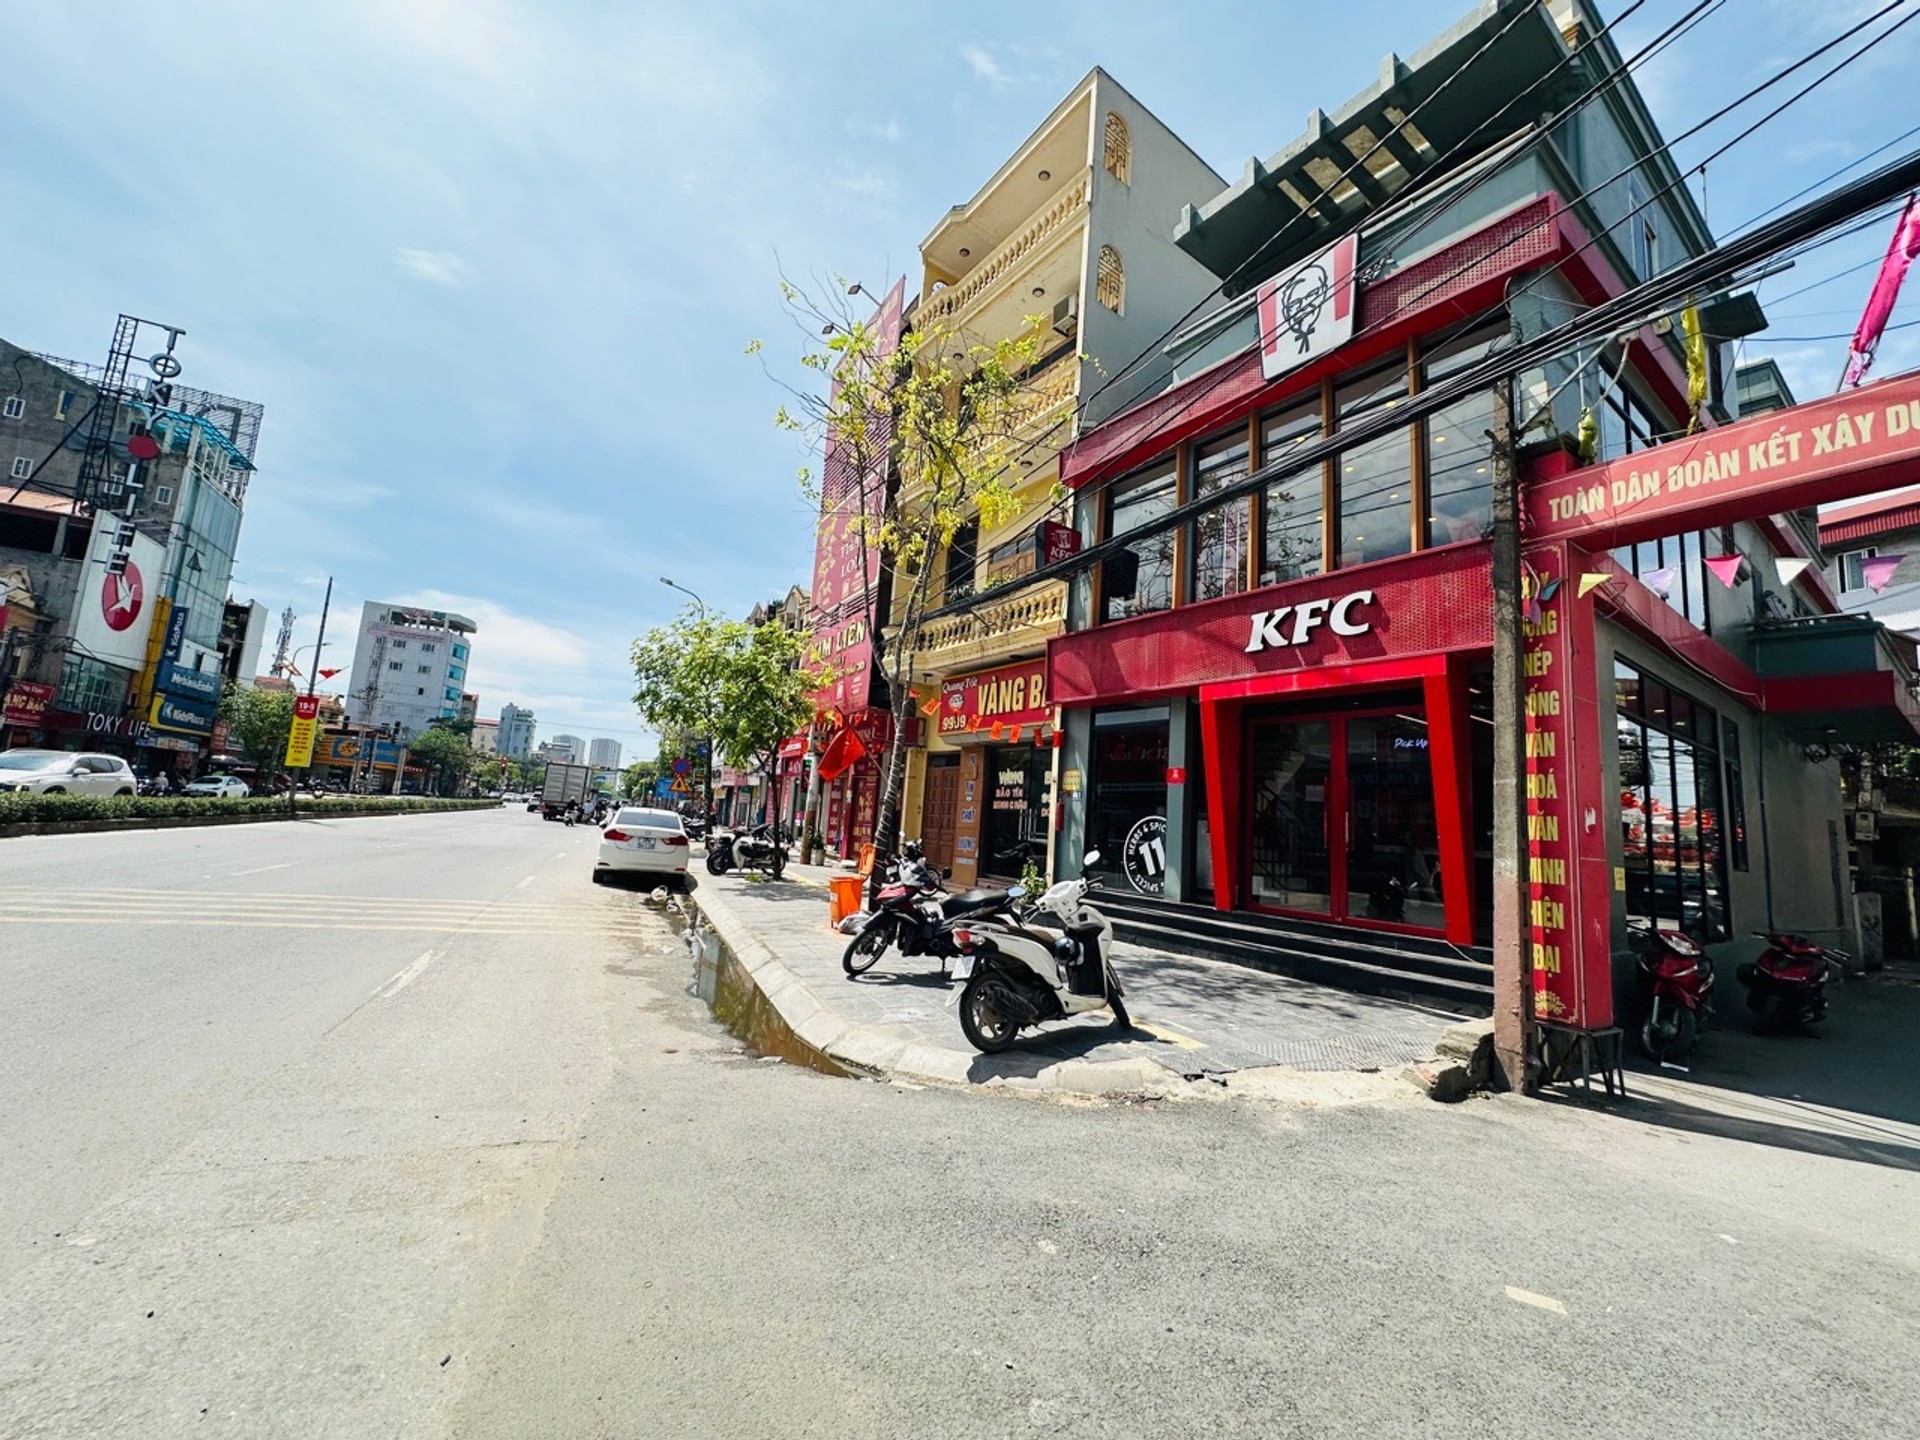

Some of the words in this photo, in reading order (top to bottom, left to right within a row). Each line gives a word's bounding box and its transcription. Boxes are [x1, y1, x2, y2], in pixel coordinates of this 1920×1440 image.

[143, 325, 186, 430] TOKY
[1548, 483, 1606, 522] TOÀN
[1611, 470, 1662, 507] DÂN
[1668, 443, 1742, 491] ĐOÀN
[1748, 425, 1803, 472] KẾT
[1810, 412, 1875, 456] XÂY
[835, 618, 866, 653] LIÊN
[1245, 590, 1374, 653] KFC
[1523, 643, 1553, 677] NẾP
[977, 675, 1026, 716] VÀNG
[1524, 684, 1561, 716] ỐNG
[86, 711, 122, 734] TOKY
[128, 719, 152, 738] LIFE
[1526, 767, 1558, 799] HOÁ
[1128, 828, 1143, 855] HERBS
[1138, 836, 1166, 876] 11
